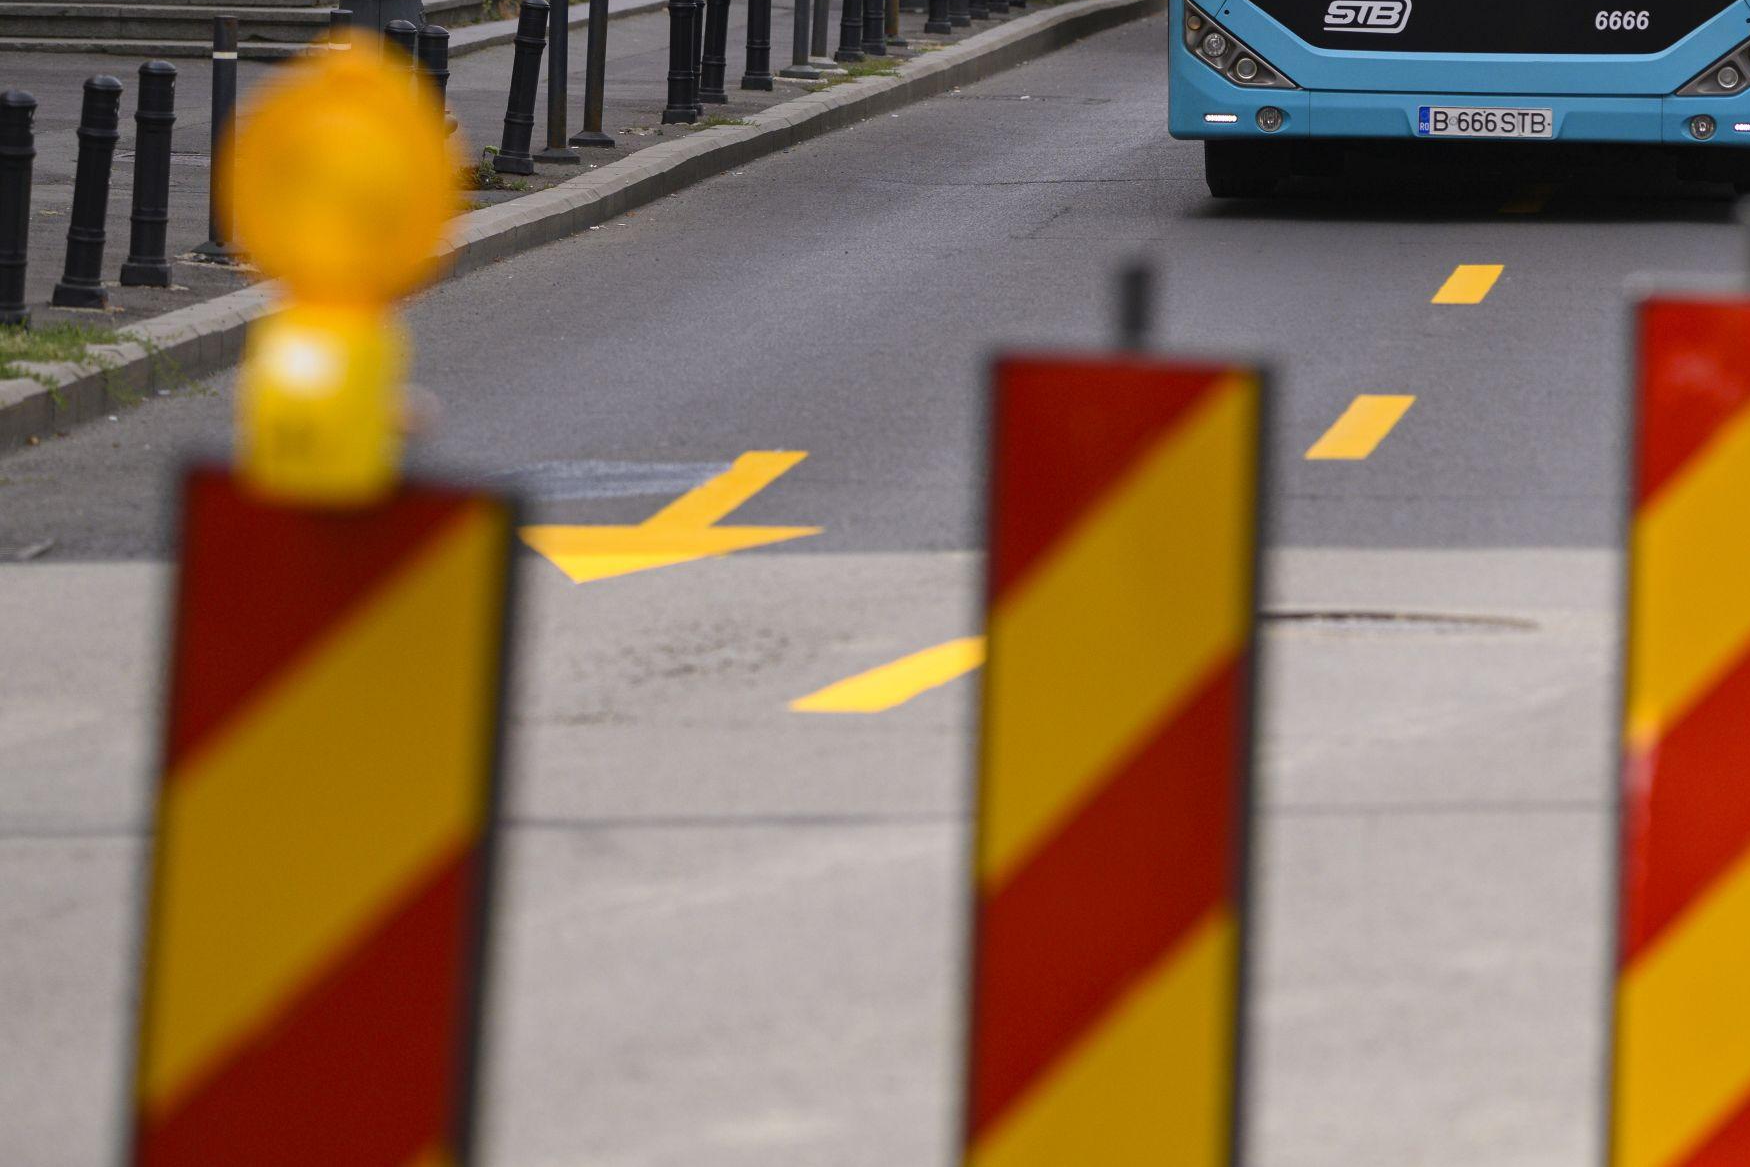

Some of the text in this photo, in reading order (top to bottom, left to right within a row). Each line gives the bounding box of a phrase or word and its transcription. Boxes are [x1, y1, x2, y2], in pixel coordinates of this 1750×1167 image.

[1323, 0, 1404, 26] STB
[1595, 10, 1650, 31] 6666
[1433, 111, 1546, 134] B 666 STB
